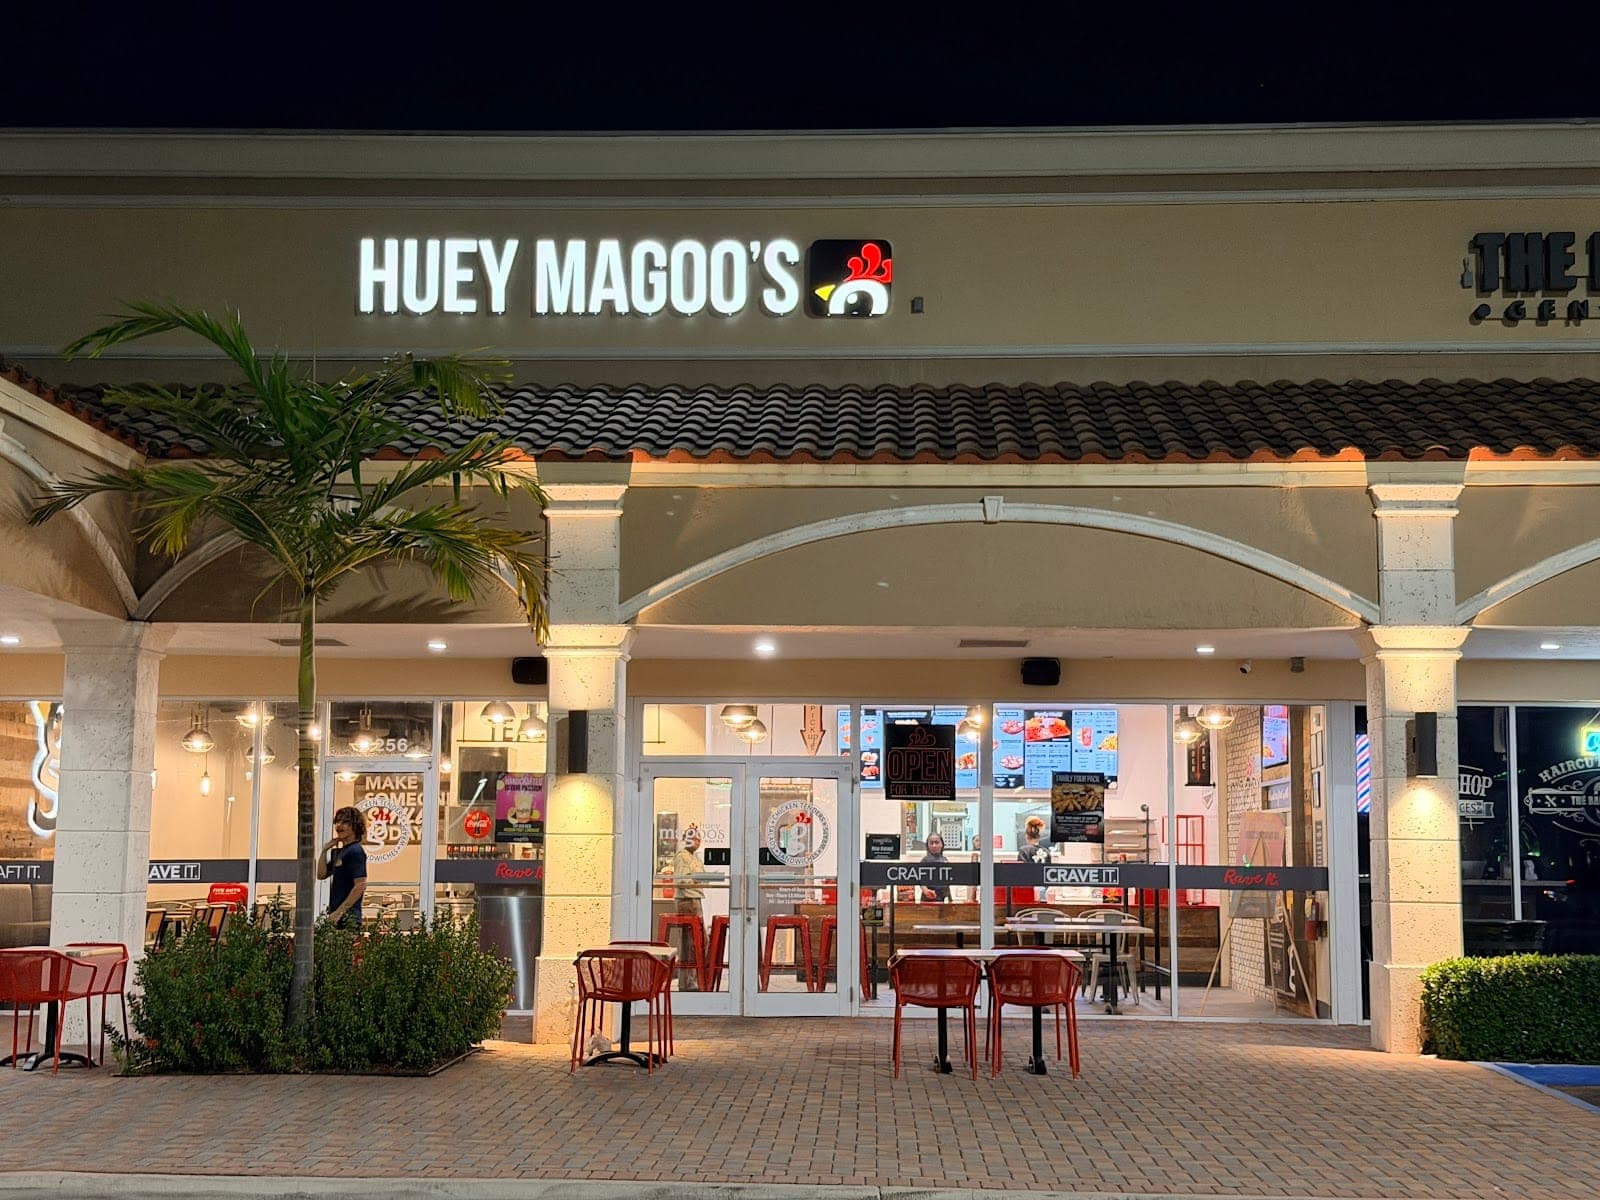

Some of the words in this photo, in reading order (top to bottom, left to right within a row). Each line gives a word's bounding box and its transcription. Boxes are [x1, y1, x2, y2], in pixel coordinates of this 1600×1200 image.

[1469, 231, 1577, 293] THE
[360, 238, 519, 313] HUEY
[536, 239, 800, 314] MAGOO'S
[1502, 300, 1600, 323] GEN
[376, 738, 408, 752] 256
[887, 750, 953, 780] OPEN
[365, 776, 418, 790] MAKE
[890, 784, 907, 795] FOR
[912, 784, 951, 795] TENDERS
[1458, 774, 1493, 797] HOP
[772, 802, 798, 820] CHICKEN
[800, 802, 826, 822] TENDERS
[366, 850, 399, 861] DWICHES
[0, 865, 24, 879] AFT
[27, 865, 41, 879] IT.
[149, 865, 180, 878] AVE
[184, 865, 198, 878] IT.
[496, 863, 533, 878] Rave
[886, 866, 936, 881] CRAFT
[939, 867, 953, 881] IT.
[1046, 868, 1098, 882] CRAVE
[1102, 869, 1116, 883] IT.
[1224, 868, 1263, 885] Rave
